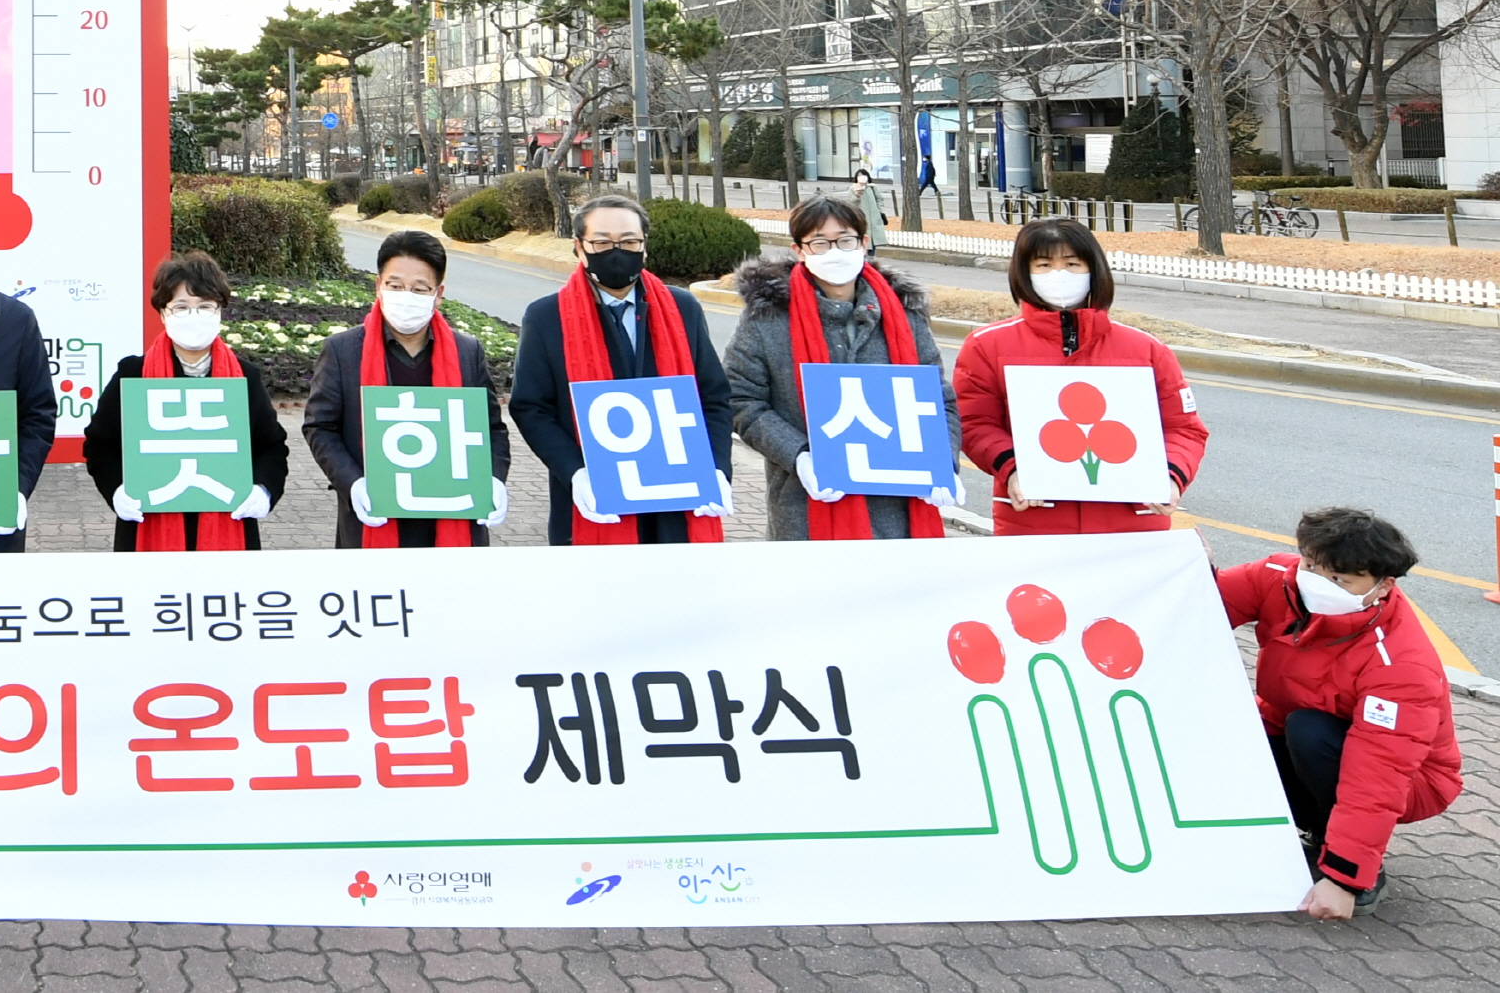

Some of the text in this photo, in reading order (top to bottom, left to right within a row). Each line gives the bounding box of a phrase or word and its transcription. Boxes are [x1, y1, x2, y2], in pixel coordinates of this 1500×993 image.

[79, 10, 109, 30] 20
[862, 72, 902, 95] Shinha
[82, 87, 107, 108] 10
[88, 165, 102, 186] 0
[820, 376, 938, 487] 산
[139, 388, 238, 506] 뜻
[375, 391, 485, 512] 한
[588, 387, 701, 503] 안
[152, 590, 298, 642] 희망을
[319, 588, 414, 639] 잇다
[128, 676, 475, 793] 온도탑
[515, 665, 861, 786] 제막식
[664, 856, 704, 870] 생생도시
[383, 871, 492, 894] 사랑의열매
[714, 896, 743, 904] ANSAN
